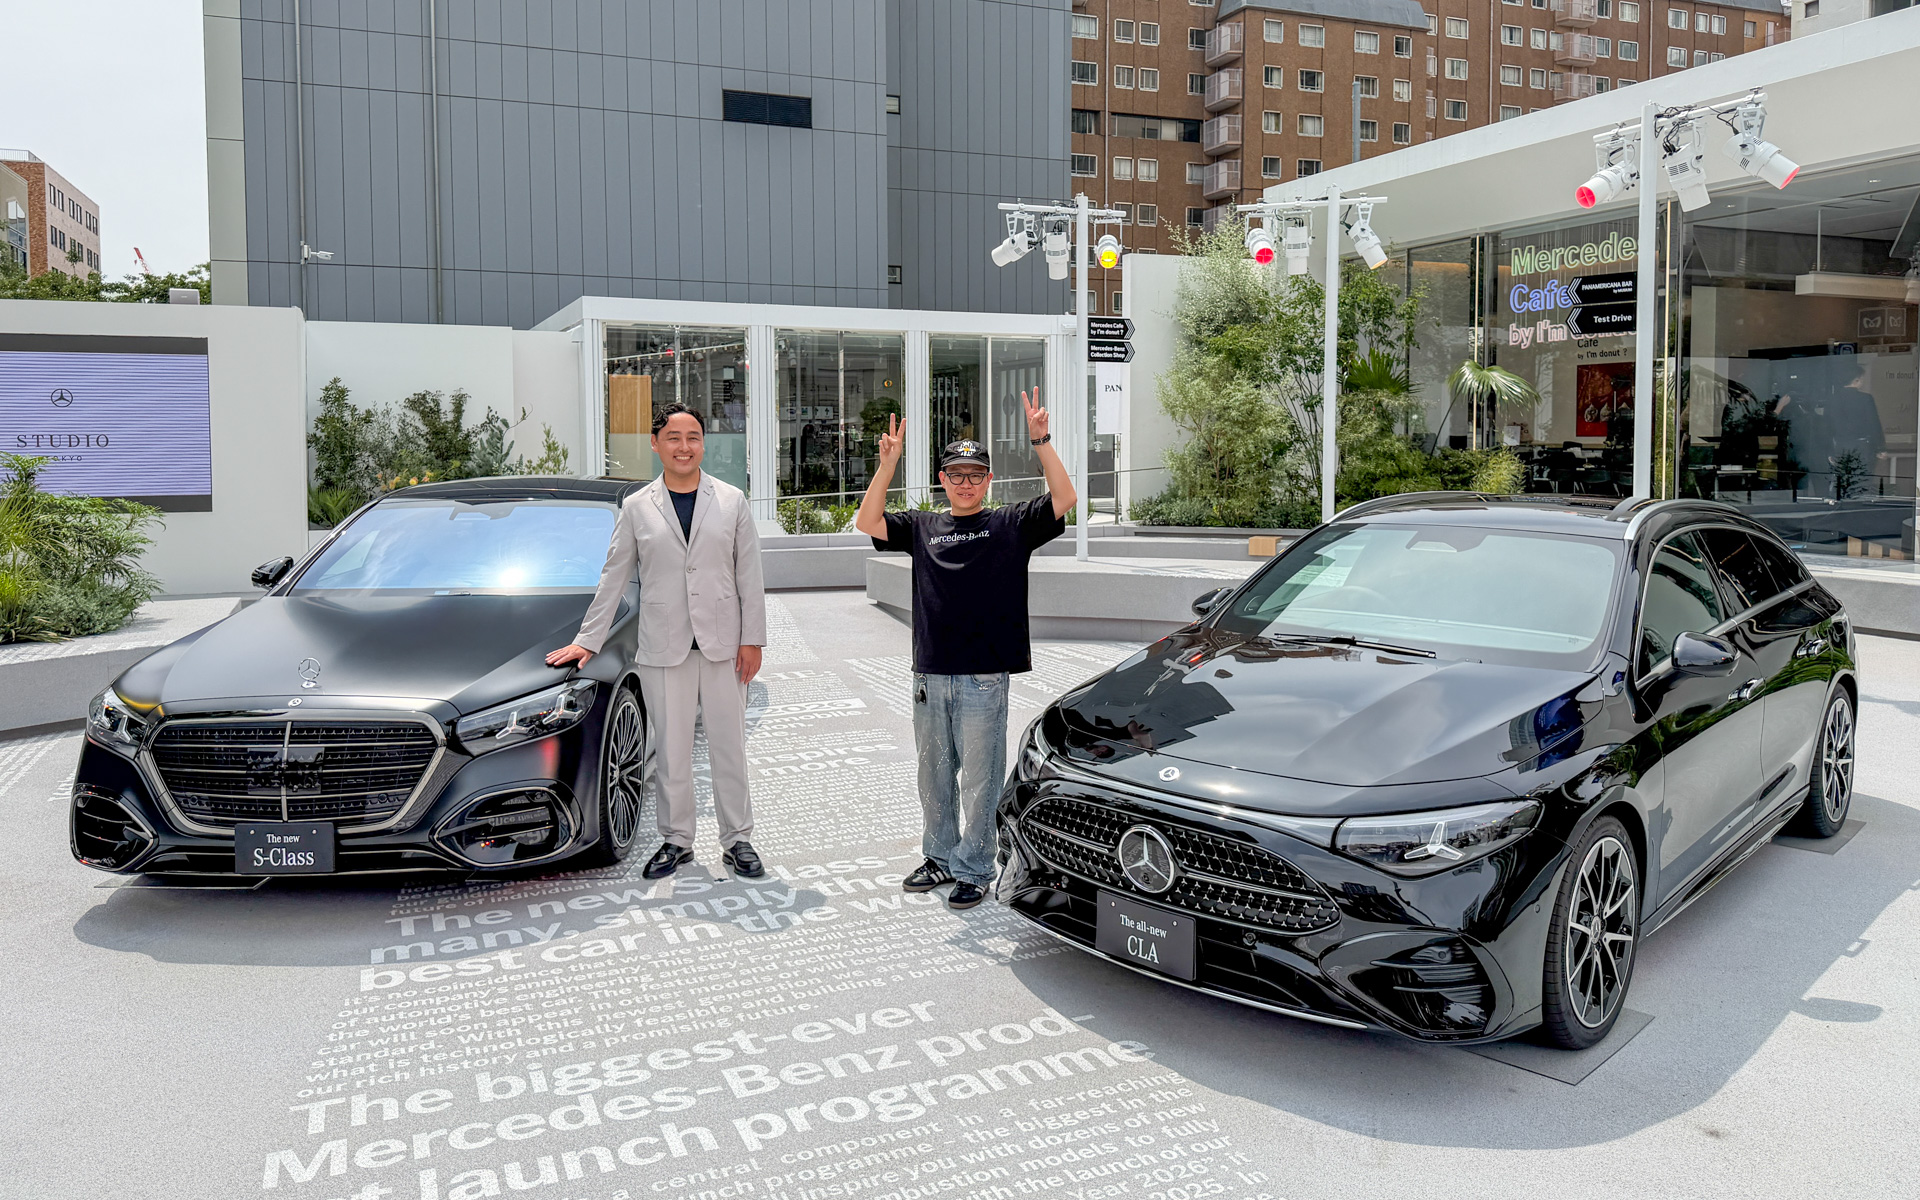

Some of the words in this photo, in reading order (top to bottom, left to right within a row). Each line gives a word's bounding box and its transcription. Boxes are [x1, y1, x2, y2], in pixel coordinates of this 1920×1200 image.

[1511, 232, 1639, 276] Mercede
[1582, 282, 1621, 290] PANAMERICANA
[1510, 280, 1572, 314] Cafe
[1509, 323, 1534, 349] by
[1536, 320, 1567, 343] I'm
[1578, 338, 1598, 348] Cafe
[17, 434, 109, 448] STUDIO
[747, 743, 897, 765] nspires
[758, 757, 870, 775] more
[254, 848, 314, 866] S-Class
[266, 834, 281, 843] The
[362, 922, 578, 971] many,
[594, 888, 798, 928] simply
[808, 873, 904, 895] the
[385, 910, 512, 935] The
[527, 886, 658, 917] new
[1120, 914, 1134, 928] The
[1136, 921, 1167, 938] all-new
[331, 1017, 358, 1028] of
[363, 998, 506, 1023] automotive
[515, 974, 653, 1000] engineering
[660, 960, 743, 977] artistry.
[747, 952, 781, 962] For
[788, 942, 848, 956] many,
[888, 924, 960, 938] S-Class
[337, 1005, 379, 1016] our
[384, 986, 508, 1009] company's
[514, 965, 645, 990] anniversary.
[647, 957, 693, 967] This
[698, 951, 729, 960] car
[770, 937, 806, 948] and
[808, 931, 846, 942] will
[848, 921, 912, 935] remain
[360, 950, 524, 990] best
[541, 932, 646, 961] car
[658, 923, 723, 943] in
[732, 904, 840, 930] the
[387, 990, 417, 999] no
[423, 968, 561, 993] coincidence
[568, 959, 616, 971] that
[619, 954, 650, 962] we
[657, 948, 690, 957] are
[696, 932, 791, 951] unveiling
[830, 918, 869, 929] new
[874, 908, 945, 922] S-Class
[1128, 935, 1159, 964] CLA
[306, 1062, 378, 1081] what
[388, 1058, 410, 1068] is
[420, 1023, 624, 1062] technologically
[633, 1003, 732, 1026] feasible
[741, 994, 784, 1008] and
[790, 978, 886, 998] building
[908, 962, 978, 977] bridge
[982, 943, 1073, 965] between
[311, 1040, 442, 1068] standard.
[457, 1028, 521, 1043] With
[534, 1018, 582, 1030] this
[596, 1000, 686, 1021] newest
[698, 978, 822, 1005] generation
[831, 968, 865, 979] we
[875, 962, 909, 972] are
[919, 952, 976, 964] again
[317, 1041, 360, 1054] car
[367, 1031, 417, 1046] will
[425, 1022, 487, 1037] soon
[496, 1006, 582, 1026] appear
[588, 1002, 612, 1010] in
[618, 990, 681, 1005] other
[689, 975, 772, 994] models
[806, 960, 846, 973] will
[850, 948, 932, 965] become
[936, 942, 971, 951] the
[325, 1029, 368, 1041] the
[378, 1013, 470, 1032] world's
[479, 1003, 533, 1017] best
[541, 992, 584, 1007] car.
[587, 988, 631, 998] The
[638, 967, 732, 991] features
[739, 962, 778, 974] and
[784, 941, 913, 966] technologies
[916, 932, 966, 944] built
[968, 926, 1008, 935] into
[290, 1089, 453, 1134] The
[476, 1001, 933, 1101] biggest-ever
[296, 1082, 346, 1097] our
[355, 1070, 409, 1087] rich
[419, 1053, 517, 1076] history
[525, 1042, 575, 1057] and
[603, 1018, 732, 1047] promising
[735, 1003, 818, 1021] future.
[262, 1046, 908, 1187] Mercedes-Benz
[916, 1008, 1093, 1066] prod-
[419, 1123, 718, 1197] launch
[733, 1041, 1152, 1150] programme
[651, 1158, 761, 1191] central
[780, 1122, 942, 1163] component
[952, 1115, 983, 1126] in
[1027, 1072, 1187, 1110] far-reaching
[764, 1143, 933, 1190] programme
[962, 1127, 1010, 1142] the
[1014, 1102, 1117, 1131] biggest
[1116, 1098, 1146, 1109] in
[1148, 1088, 1192, 1102] the
[797, 1169, 899, 1198] inspire
[902, 1157, 957, 1180] you
[959, 1142, 1024, 1163] with
[1028, 1123, 1120, 1148] dozens
[1124, 1112, 1150, 1127] of
[1153, 1103, 1205, 1121] new
[1014, 1176, 1064, 1193] the
[1063, 1153, 1157, 1182] launch
[1160, 1143, 1188, 1159] of
[1190, 1135, 1231, 1152] our
[1018, 1142, 1118, 1171] models
[1124, 1135, 1154, 1146] to
[1160, 1119, 1219, 1137] fully
[1235, 1171, 1268, 1184] In
